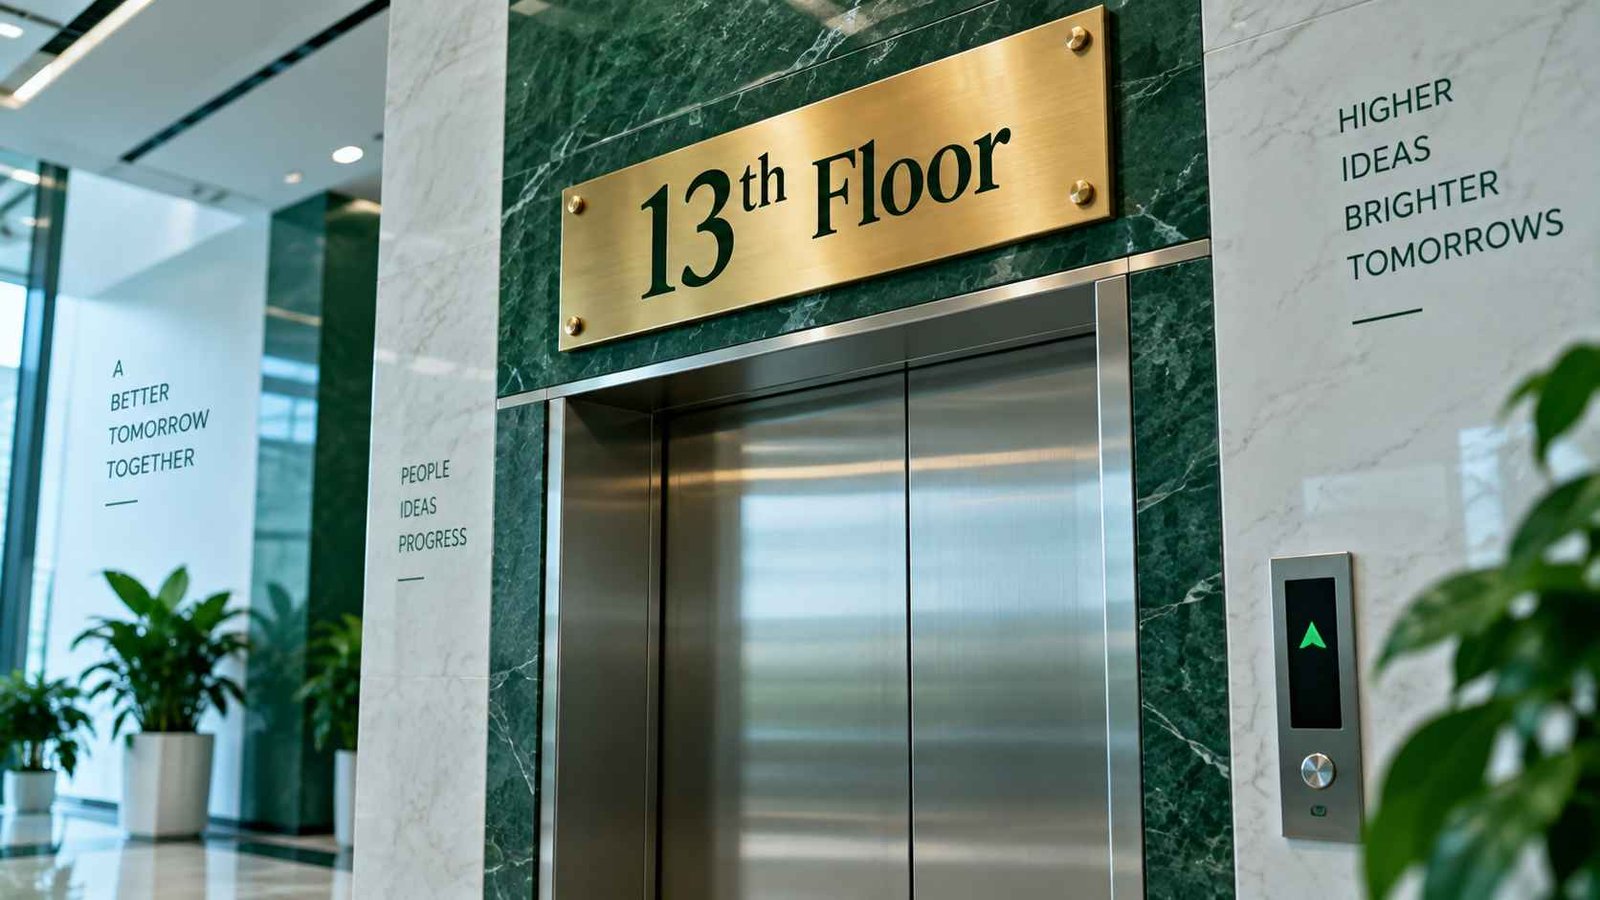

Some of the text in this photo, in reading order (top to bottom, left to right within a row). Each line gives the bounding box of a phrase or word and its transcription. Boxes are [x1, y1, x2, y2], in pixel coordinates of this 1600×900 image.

[1338, 78, 1453, 134] HIGHER
[1342, 135, 1431, 182] IDEAS
[640, 126, 1011, 300] 13th Floor
[1344, 169, 1500, 232] BRIGHTER
[1346, 208, 1564, 281] TOMORROWS
[112, 359, 124, 379] A
[110, 382, 170, 412] BETTER
[108, 409, 211, 446] TOMORROW
[106, 447, 195, 480] TOGETHER
[400, 459, 451, 486] PEOPLE
[400, 496, 437, 519] IDEAS
[398, 526, 468, 554] PROGRESS
